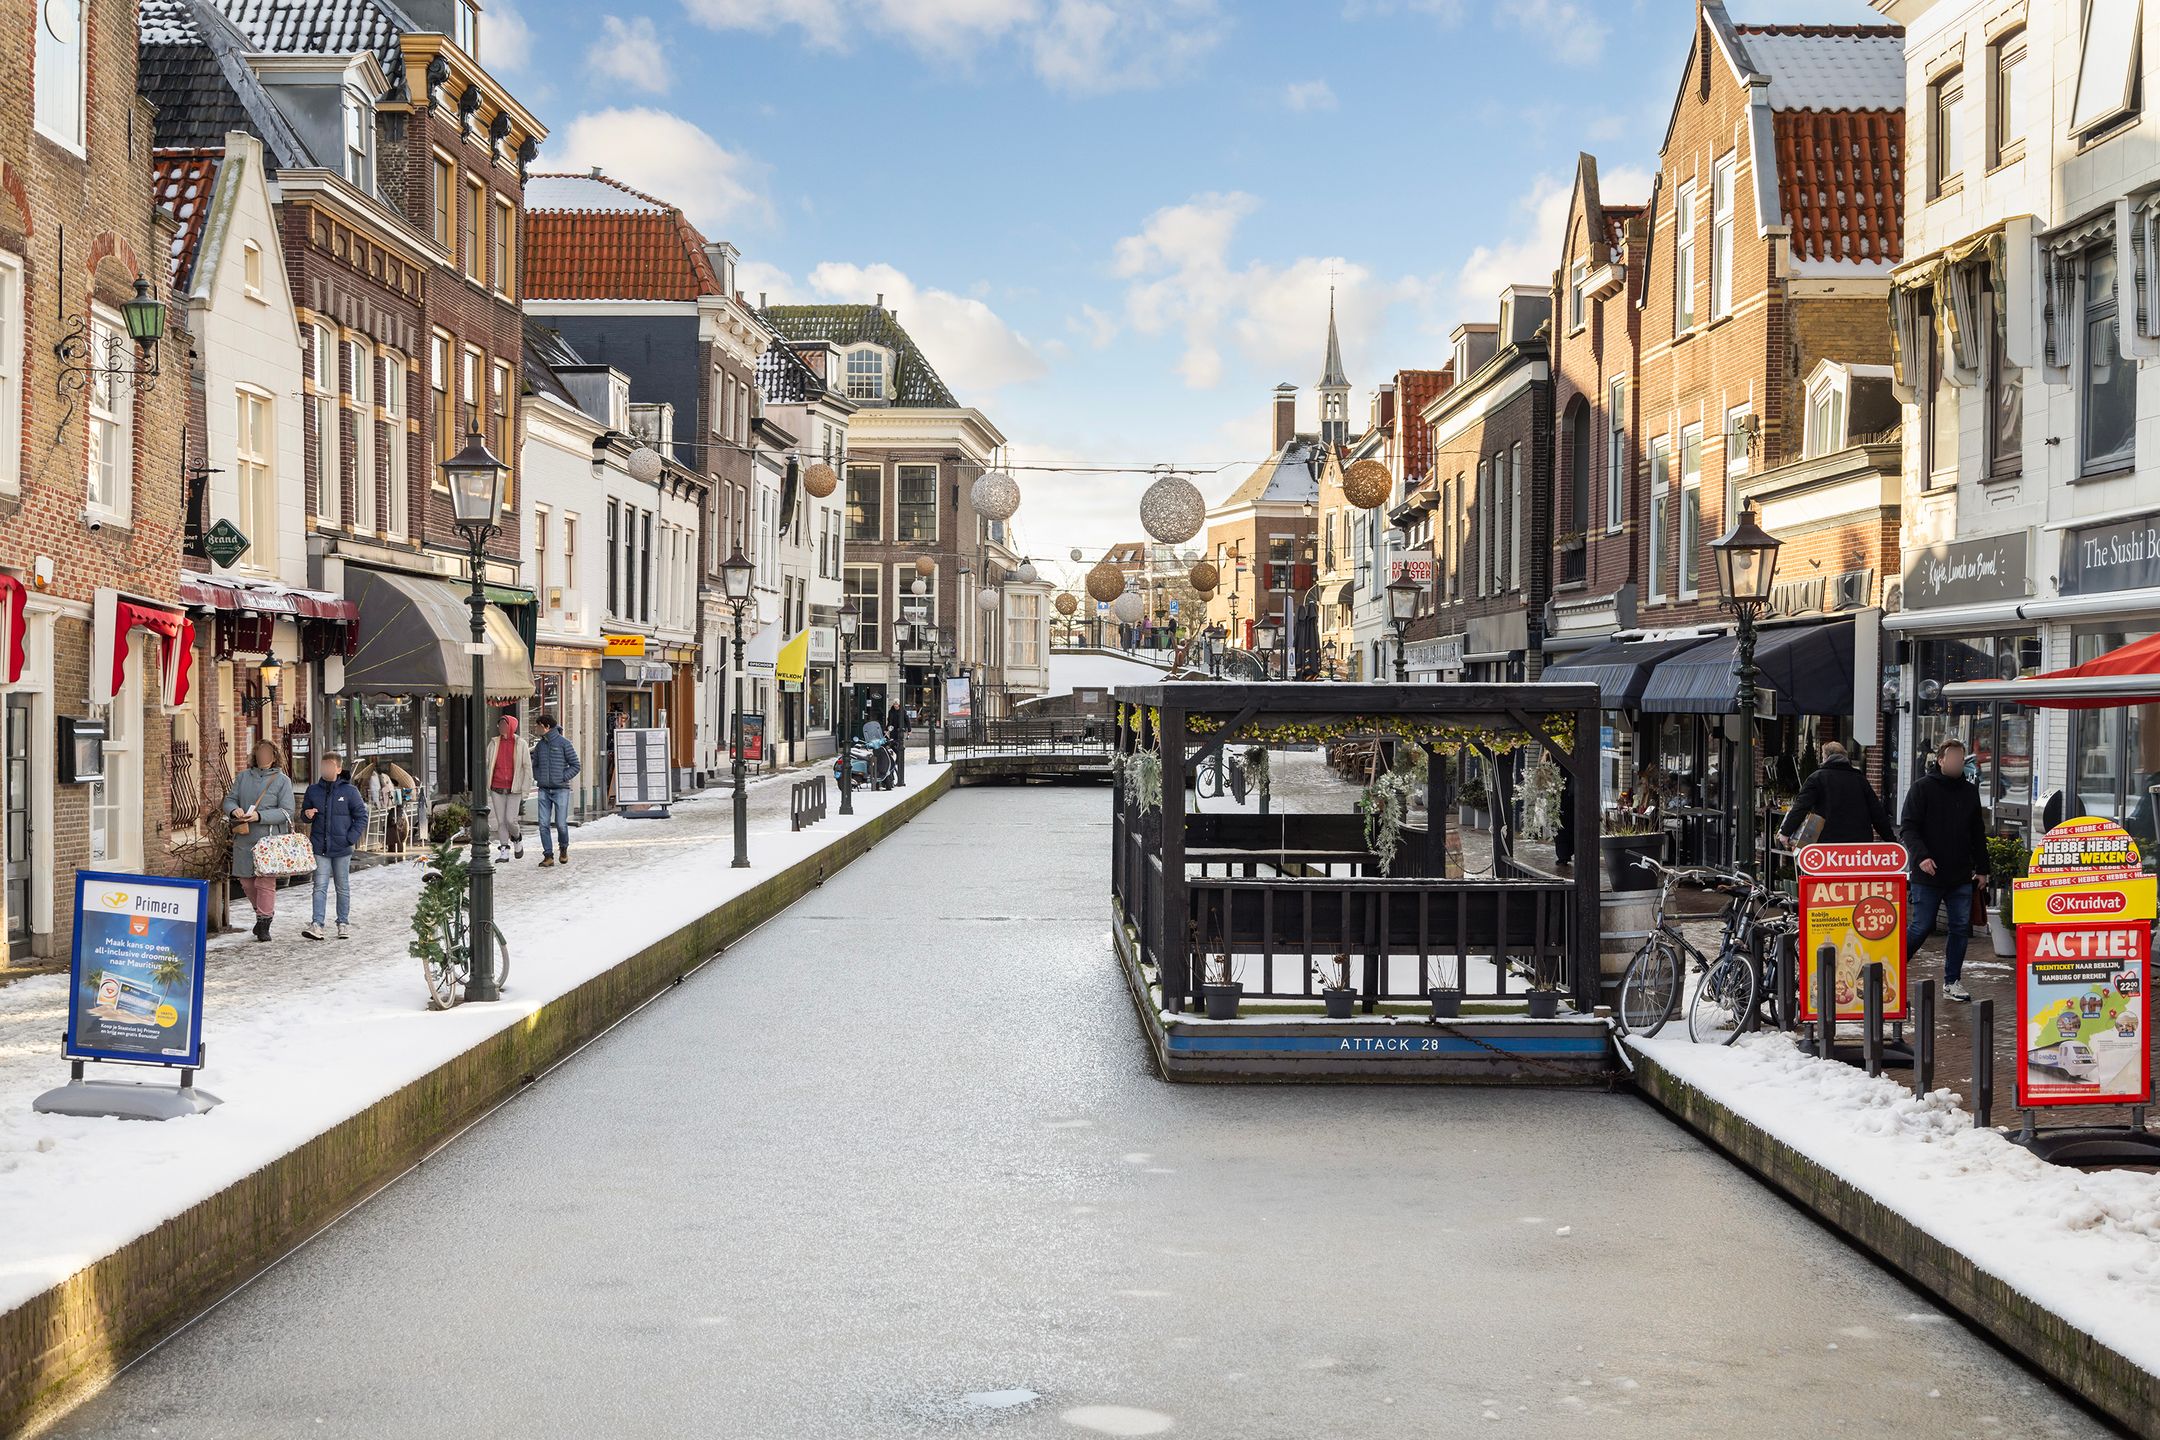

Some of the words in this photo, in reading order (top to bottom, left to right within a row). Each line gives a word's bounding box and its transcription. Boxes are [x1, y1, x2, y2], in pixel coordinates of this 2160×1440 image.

[208, 534, 238, 545] Brand
[2084, 537, 2108, 569] The
[2110, 530, 2143, 565] Sushi
[1392, 561, 1402, 570] DE
[1948, 554, 1967, 584] Lunch
[1967, 567, 1976, 577] en
[1392, 570, 1431, 579] MSTER
[608, 638, 639, 646] DHL
[777, 672, 803, 680] WELKOM
[2074, 824, 2097, 833] HEBBE
[2045, 841, 2086, 854] HEBBE
[2087, 840, 2128, 852] HEBBE
[1826, 849, 1899, 867] Kruidvat
[2039, 853, 2080, 866] HEBBE
[2080, 851, 2126, 865] WEKEN
[2020, 880, 2043, 889] HEBBE
[2049, 877, 2072, 886] HEBBE
[2077, 875, 2100, 883] HEBBE
[2106, 872, 2128, 880] HEBBE
[1812, 881, 1894, 903] ACTIE!
[135, 895, 179, 915] Primera
[1864, 904, 1871, 914] 2
[2066, 896, 2121, 910] Kruidvat
[105, 937, 125, 948] Maak
[126, 939, 144, 950] kans
[144, 943, 155, 952] op
[2034, 929, 2138, 958] ACTIE!
[94, 946, 140, 958] all-inclusive
[141, 951, 179, 963] droomreis
[109, 958, 126, 966] naar
[127, 958, 163, 971] Mauritius
[2035, 963, 2075, 971] TREINTICKET
[2075, 962, 2093, 970] NAAR
[2093, 961, 2121, 969] BERLIJN,
[2041, 973, 2072, 982] HAMBURG
[2081, 972, 2107, 980] BREMEN
[1340, 1038, 1409, 1051] ATTACK
[1421, 1038, 1439, 1051] 28
